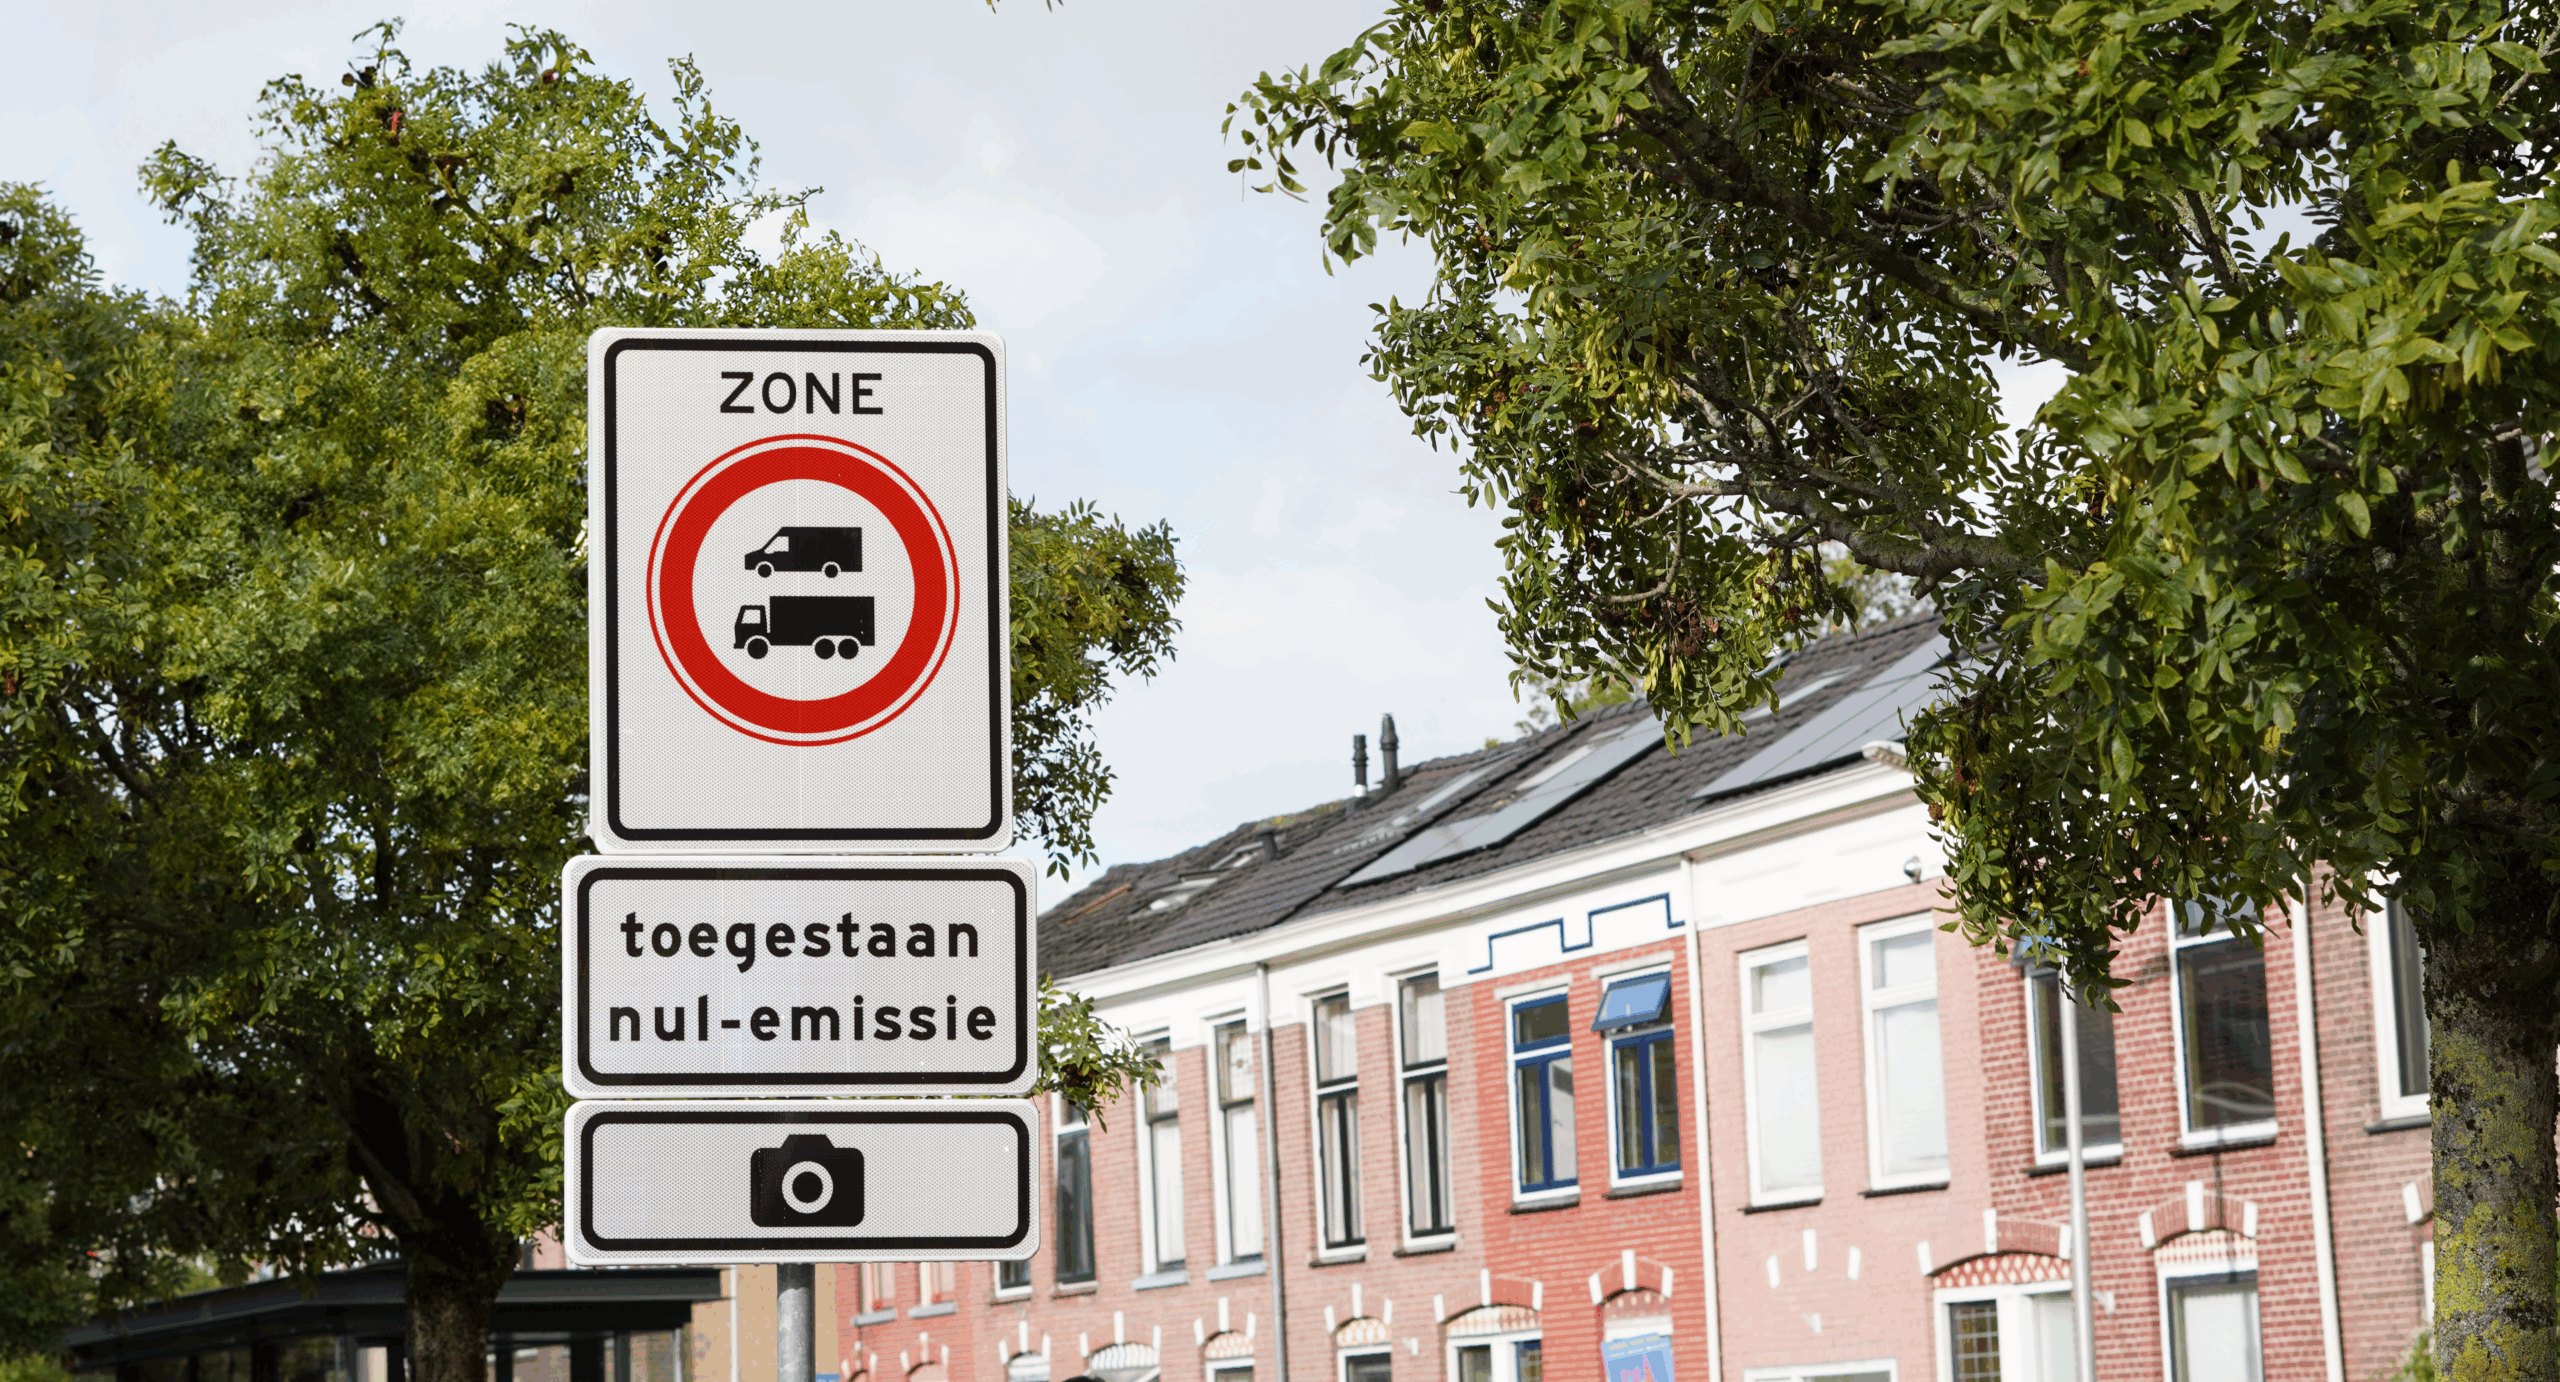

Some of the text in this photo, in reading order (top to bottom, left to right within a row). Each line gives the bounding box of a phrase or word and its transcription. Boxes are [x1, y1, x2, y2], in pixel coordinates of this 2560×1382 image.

[720, 371, 883, 415] ZONE
[620, 911, 979, 974] toegestaan
[609, 994, 997, 1042] nul-emissie
